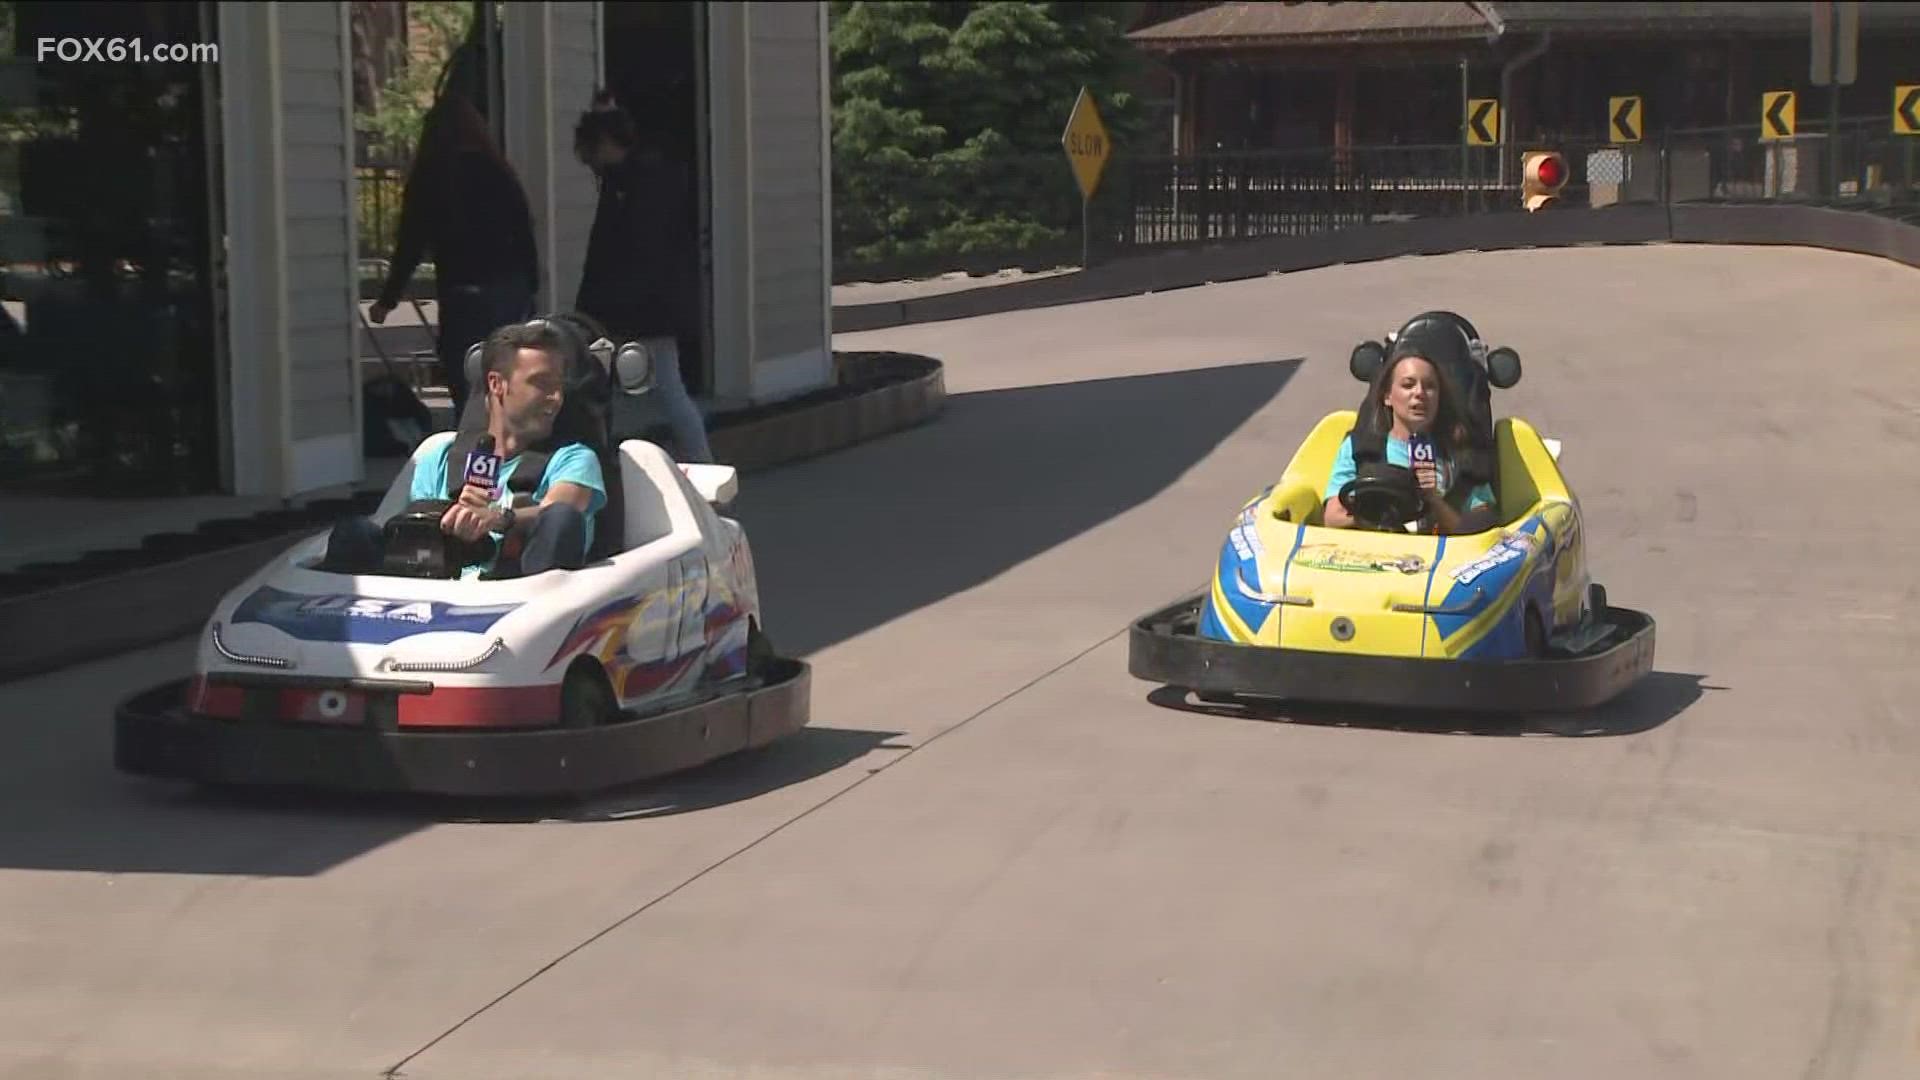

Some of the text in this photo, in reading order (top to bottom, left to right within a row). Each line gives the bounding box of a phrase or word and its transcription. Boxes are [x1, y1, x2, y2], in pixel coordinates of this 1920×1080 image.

[1071, 132, 1102, 156] SLOW
[1414, 443, 1433, 460] 61
[472, 455, 497, 478] 61
